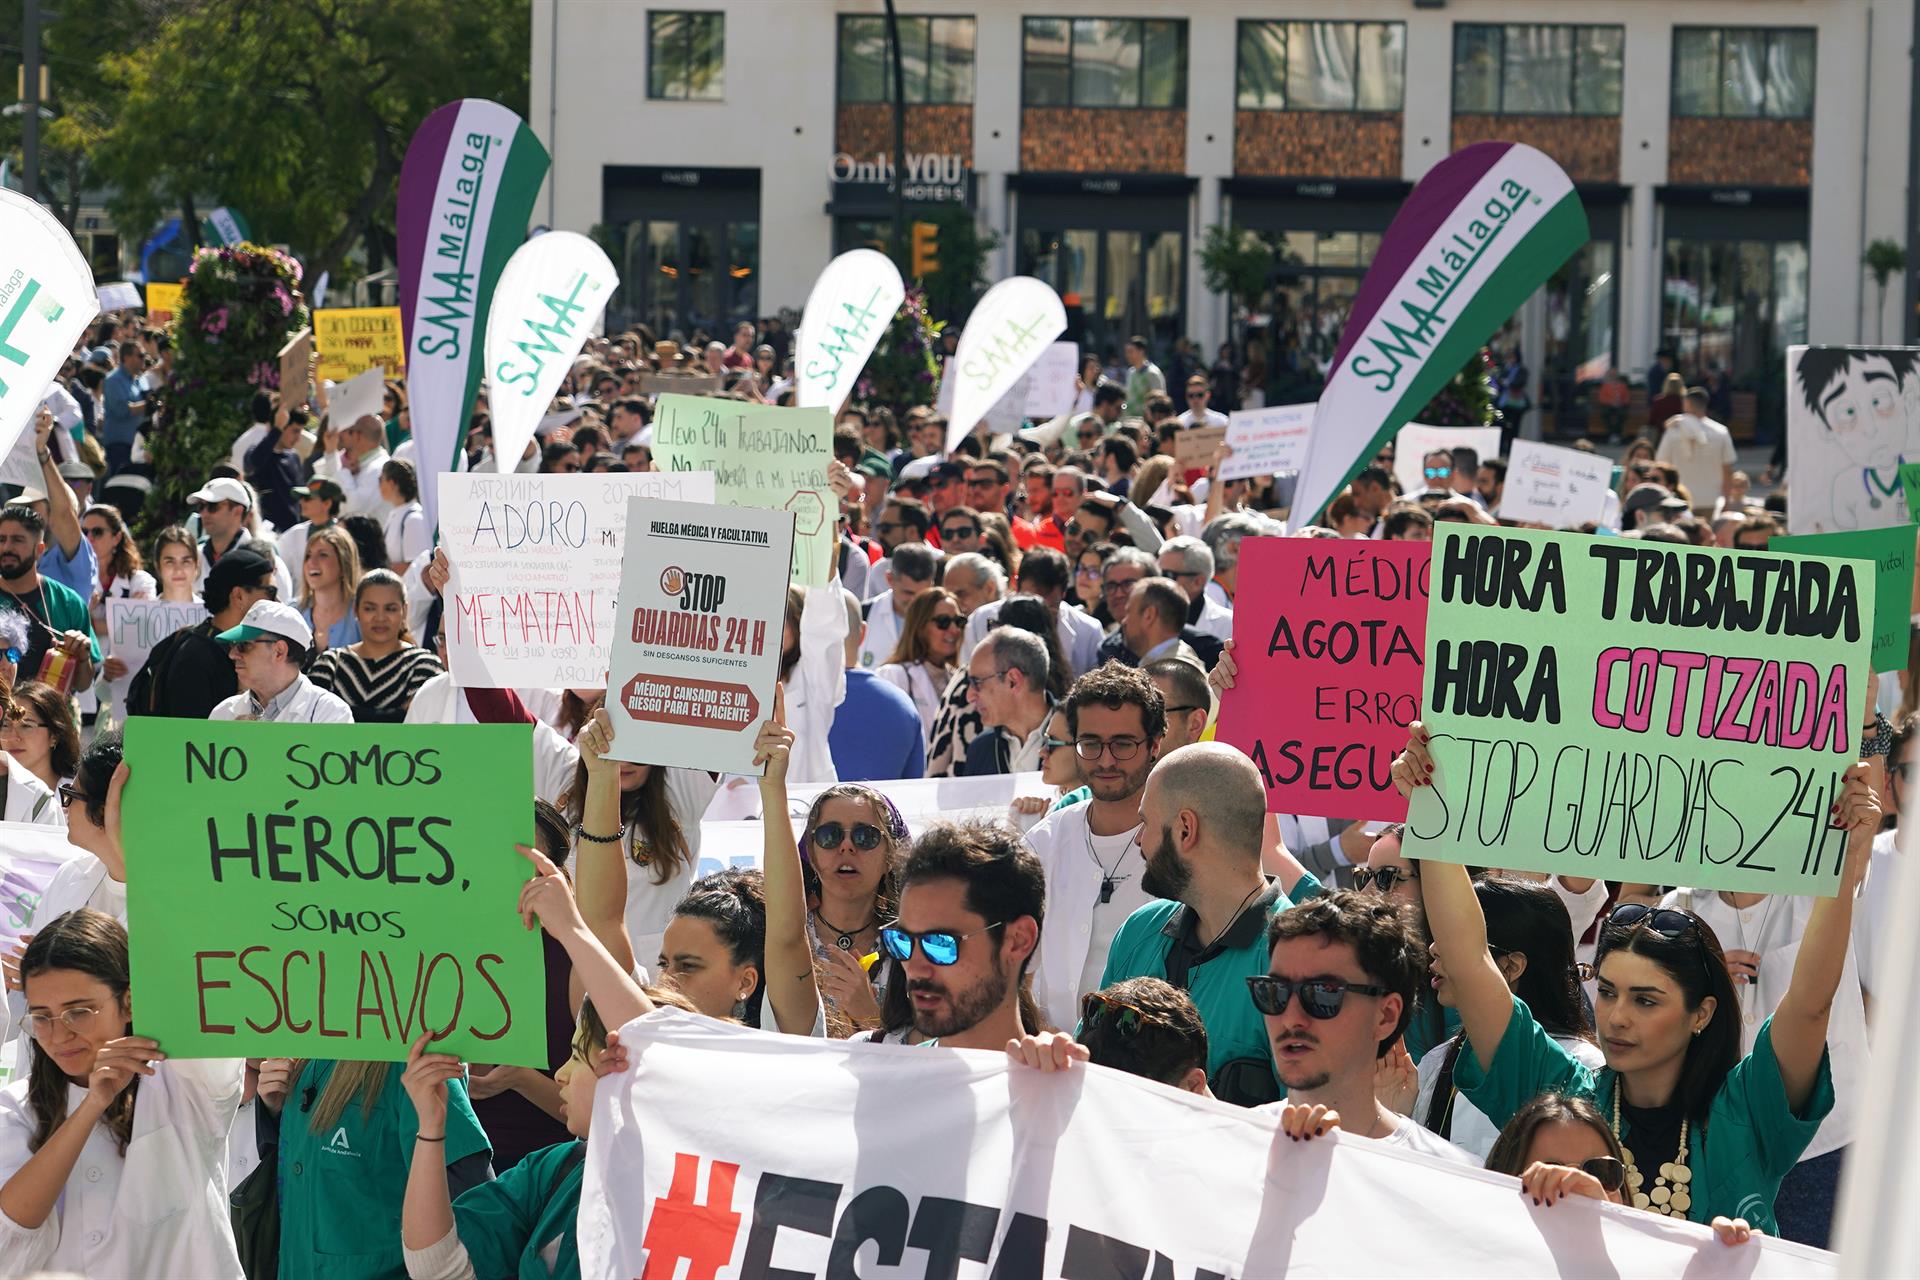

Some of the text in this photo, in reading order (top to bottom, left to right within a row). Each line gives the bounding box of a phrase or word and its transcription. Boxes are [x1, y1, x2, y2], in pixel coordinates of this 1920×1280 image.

[828, 153, 962, 192] Only YOU
[903, 186, 964, 201] HOTELS
[418, 131, 484, 360] SMA Málaga
[1351, 298, 1447, 394] SMA
[1417, 177, 1526, 299] Málaga
[497, 285, 586, 396] SMA
[806, 293, 878, 390] SMA
[963, 317, 1042, 391] SMA
[473, 501, 586, 549] ADORO
[650, 521, 768, 545] HUELGA MÉDICA Y FACULTATIVA
[680, 571, 726, 614] STOP
[1301, 550, 1431, 600] MÉDIC
[1441, 534, 1861, 643] HORA TRABAJADA
[455, 590, 595, 648] ME MATAN
[631, 607, 766, 657] GUARDIAS 24 H
[1267, 615, 1423, 667] AGOTA
[643, 650, 748, 668] SIN DESCANSOS SUFICIENTES
[628, 695, 750, 723] RIESGO PARA EL PACIENTE
[634, 679, 748, 706] MÉDICO CANSADO ES UN
[1315, 686, 1422, 728] ERRO
[1432, 639, 1850, 754] HORA COTIZADA
[185, 741, 443, 790] NO SOMOS
[1251, 739, 1406, 793] ASEGU
[1411, 733, 1850, 878] STOP GUARDIAS 24H
[207, 800, 471, 892] HÉROES,
[271, 902, 406, 938] SOMOS
[194, 945, 512, 1045] ESCLAVOS
